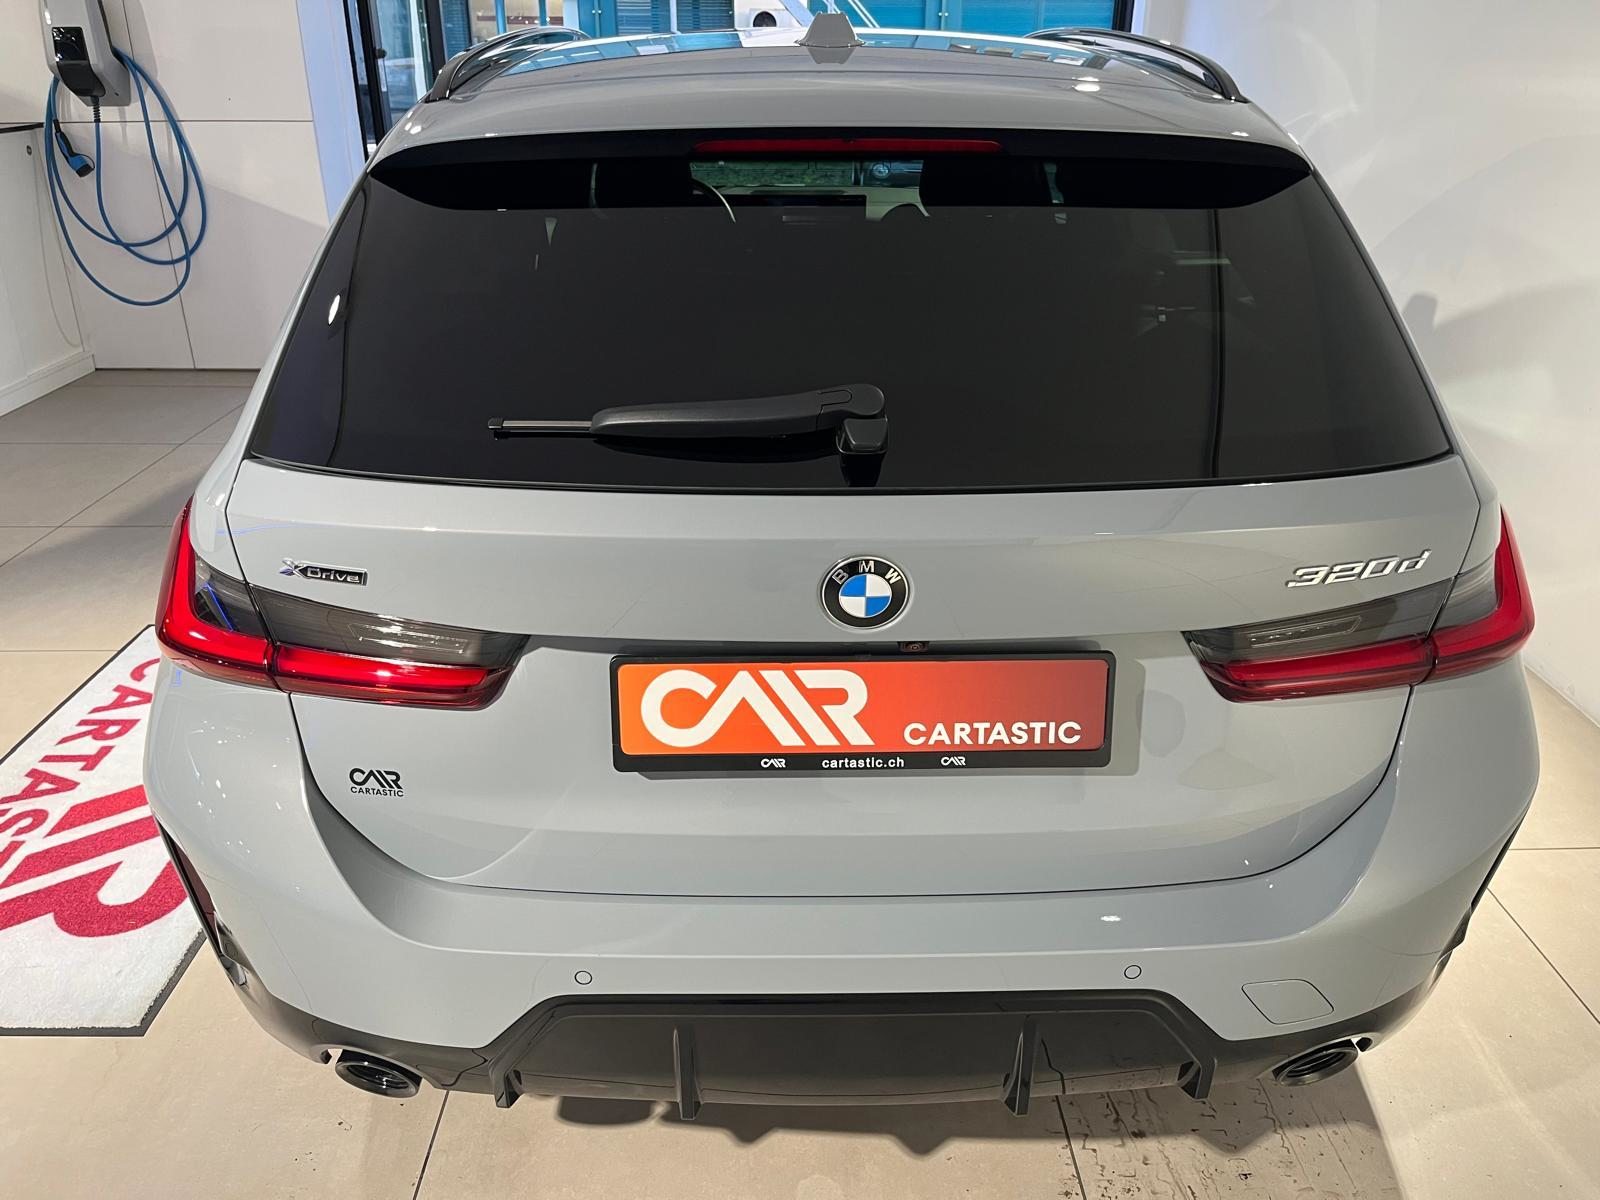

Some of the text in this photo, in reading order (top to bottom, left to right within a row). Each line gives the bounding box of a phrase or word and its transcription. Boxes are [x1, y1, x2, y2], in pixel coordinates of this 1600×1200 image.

[831, 559, 902, 585] BMW
[1286, 549, 1433, 588] 320d
[903, 720, 1082, 746] CARTASTIC
[821, 756, 905, 769] cartastic.ch
[350, 786, 404, 798] CARTASTIC
